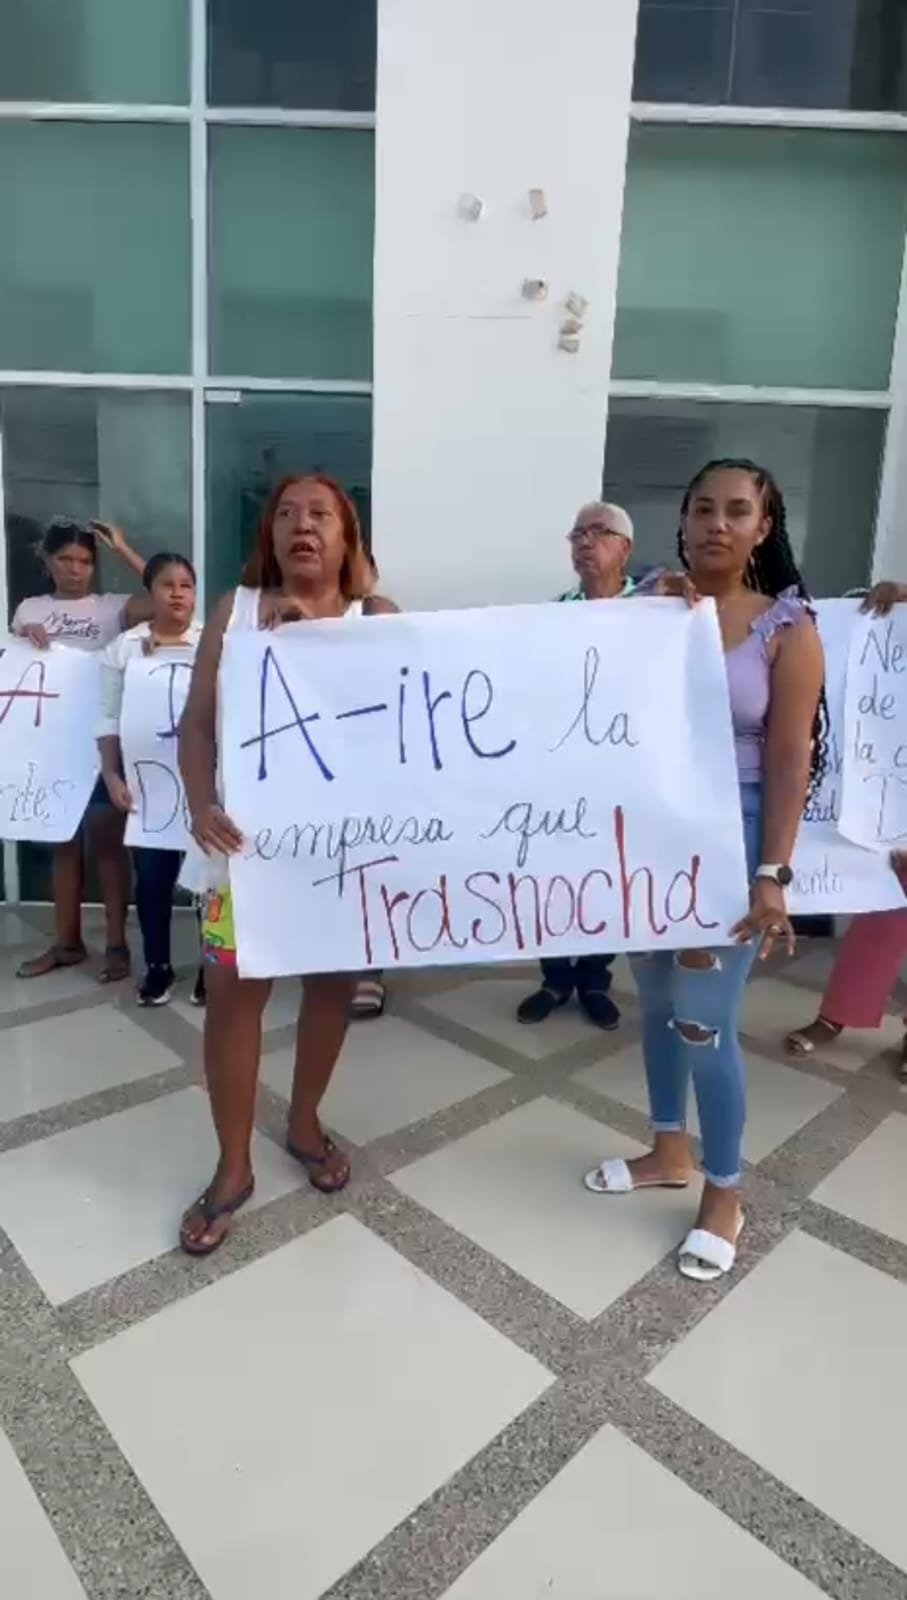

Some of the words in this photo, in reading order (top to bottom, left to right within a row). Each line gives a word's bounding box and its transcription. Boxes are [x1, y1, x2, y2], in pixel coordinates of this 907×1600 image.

[549, 646, 639, 752] la
[854, 719, 875, 763] la
[857, 671, 896, 720] de
[243, 812, 454, 897] empresa
[480, 797, 598, 867] que
[312, 806, 720, 965] Trasnocha
